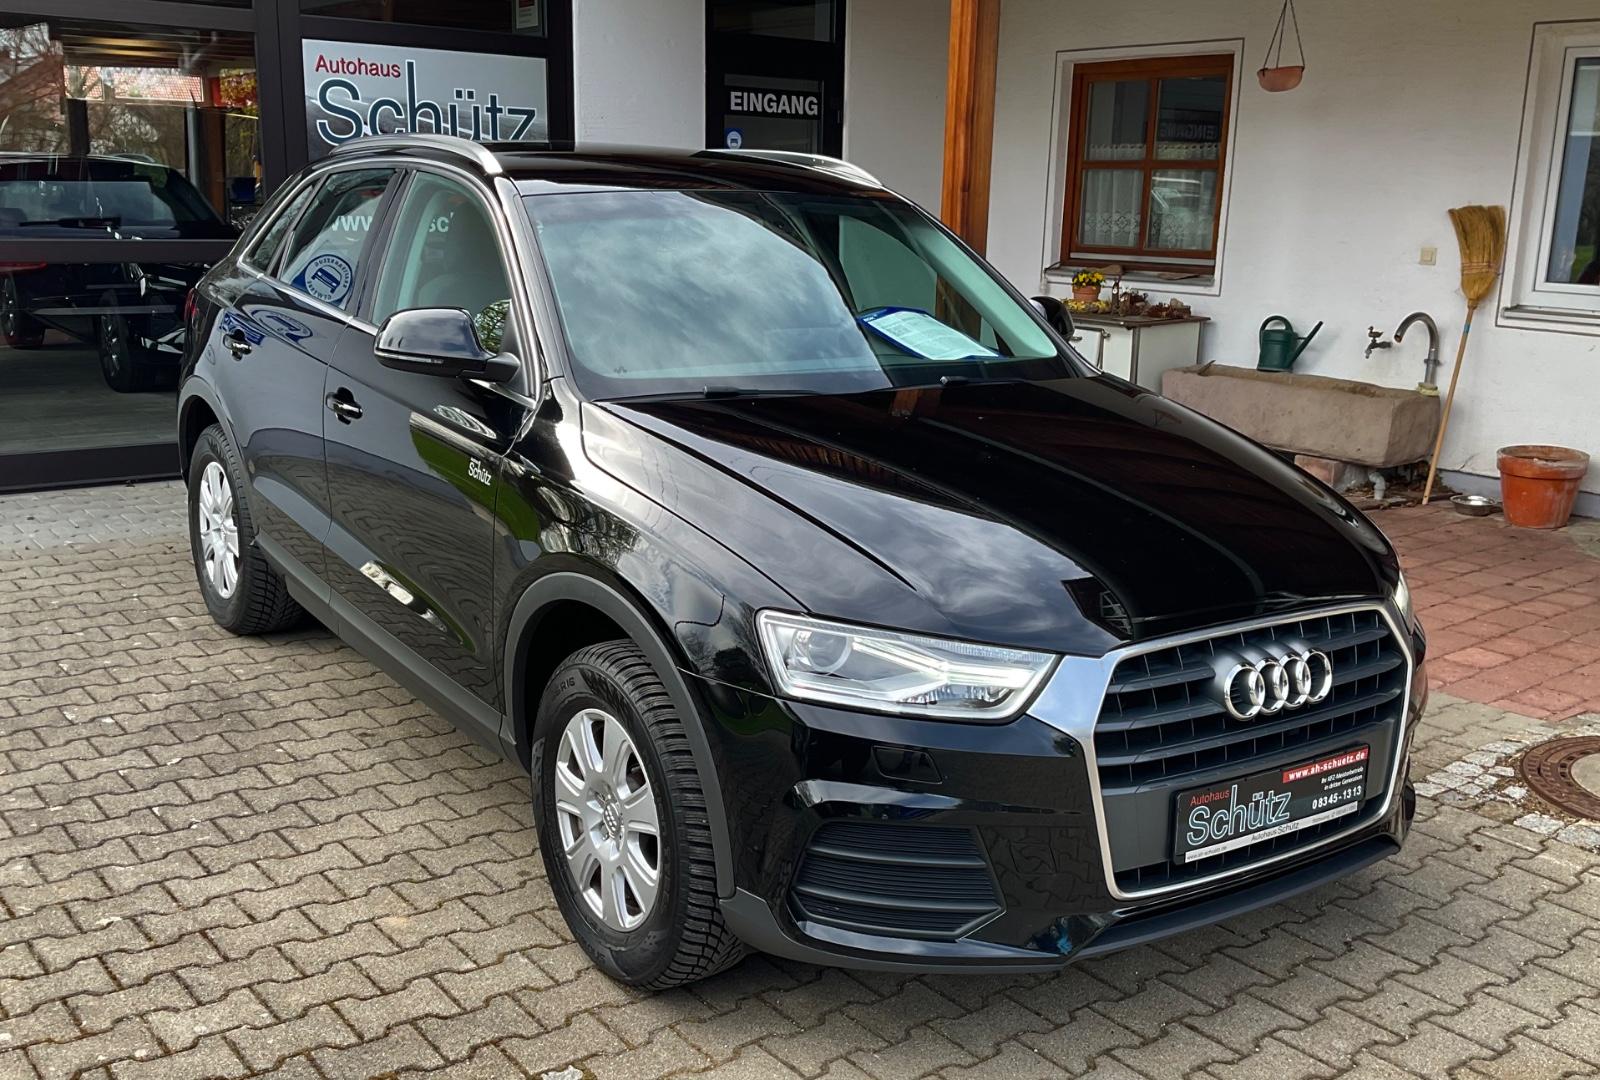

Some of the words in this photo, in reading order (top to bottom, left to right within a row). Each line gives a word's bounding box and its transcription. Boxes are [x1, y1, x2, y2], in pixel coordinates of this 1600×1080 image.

[315, 54, 401, 78] Autohaus
[316, 59, 537, 146] Schütz
[730, 91, 818, 115] EINGANG
[468, 460, 492, 486] Schütz
[1288, 751, 1365, 781] www.ah-schuetz.de
[1190, 789, 1230, 806] Autohaus
[1312, 785, 1362, 810] 08345-1313
[1186, 784, 1292, 846] Schütz
[1251, 830, 1277, 842] Autohaus
[1278, 821, 1300, 835] Schütz
